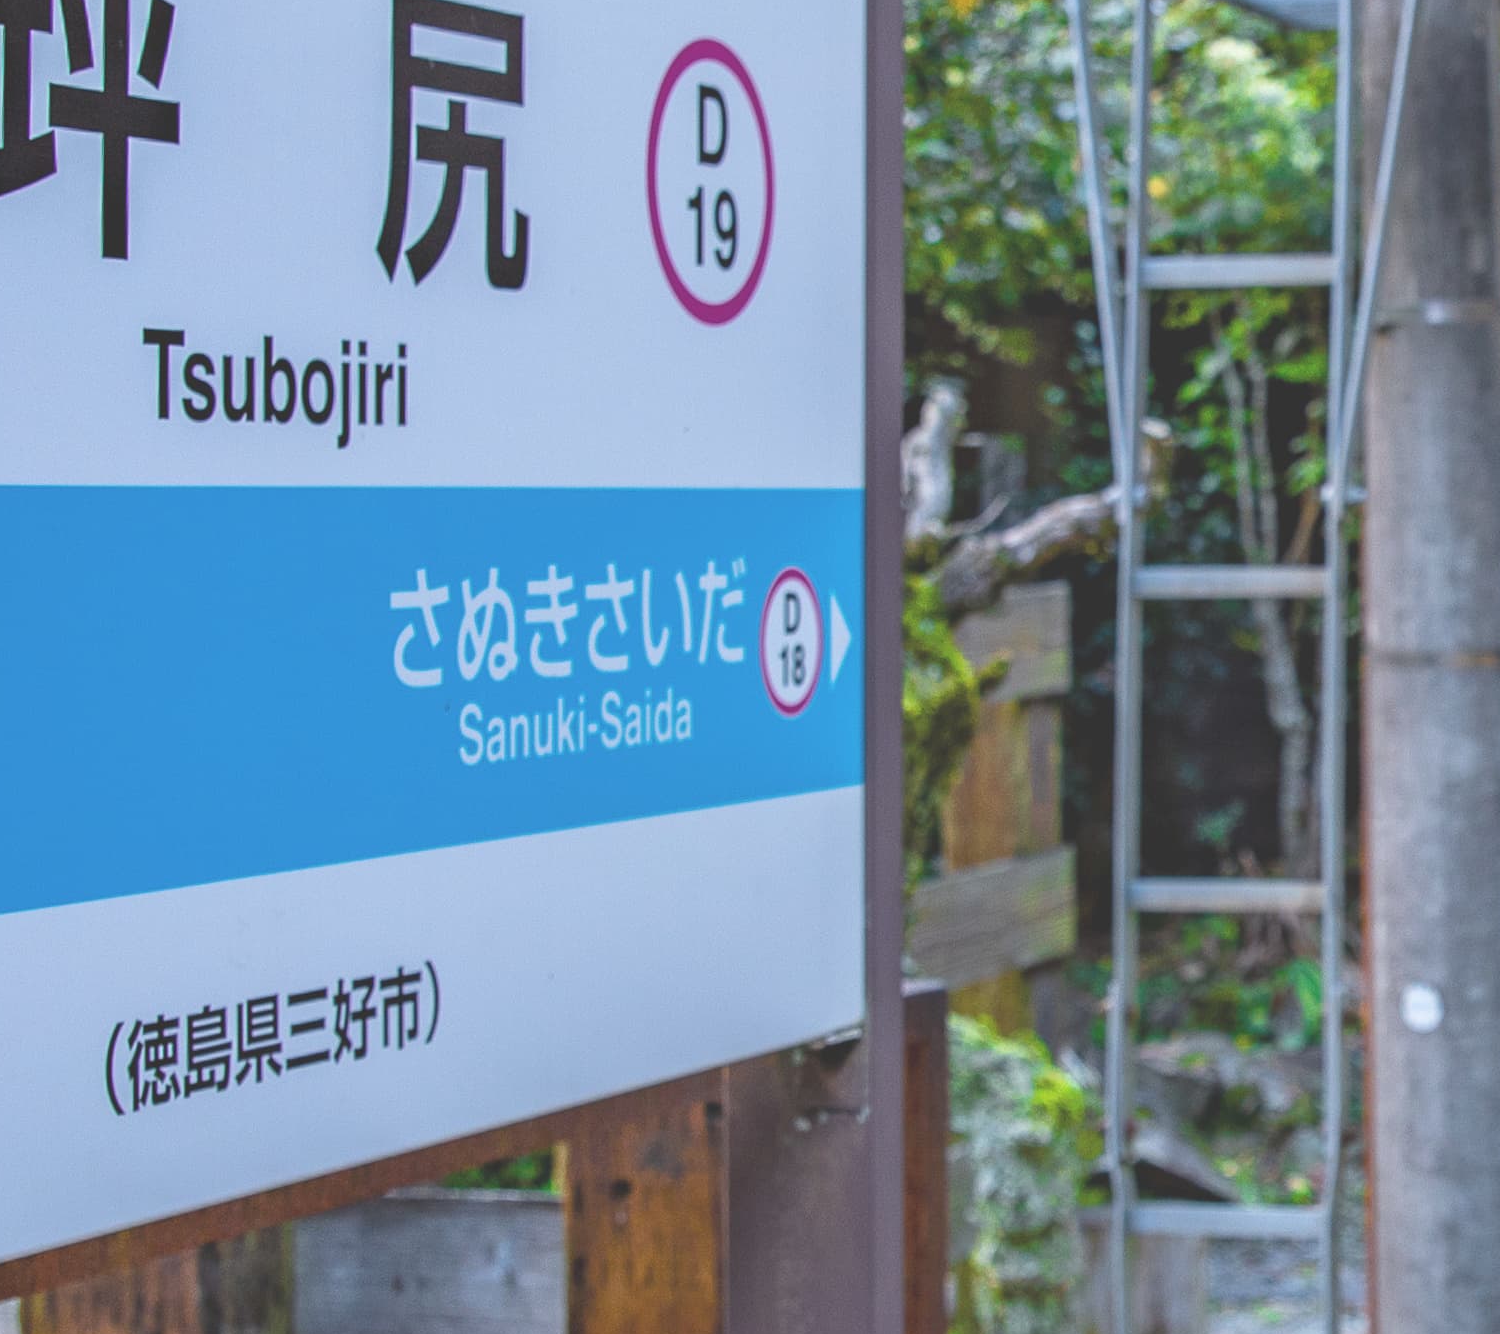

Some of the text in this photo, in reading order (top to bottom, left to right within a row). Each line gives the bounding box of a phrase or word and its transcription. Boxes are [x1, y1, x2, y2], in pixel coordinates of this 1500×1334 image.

[697, 83, 729, 167] D
[687, 185, 739, 271] 19
[142, 326, 408, 450] Tsubojiri
[389, 557, 747, 688] さぬきさいだ
[783, 591, 801, 636] D
[779, 643, 807, 687] 18
[458, 686, 693, 767] Sanuki-Saida
